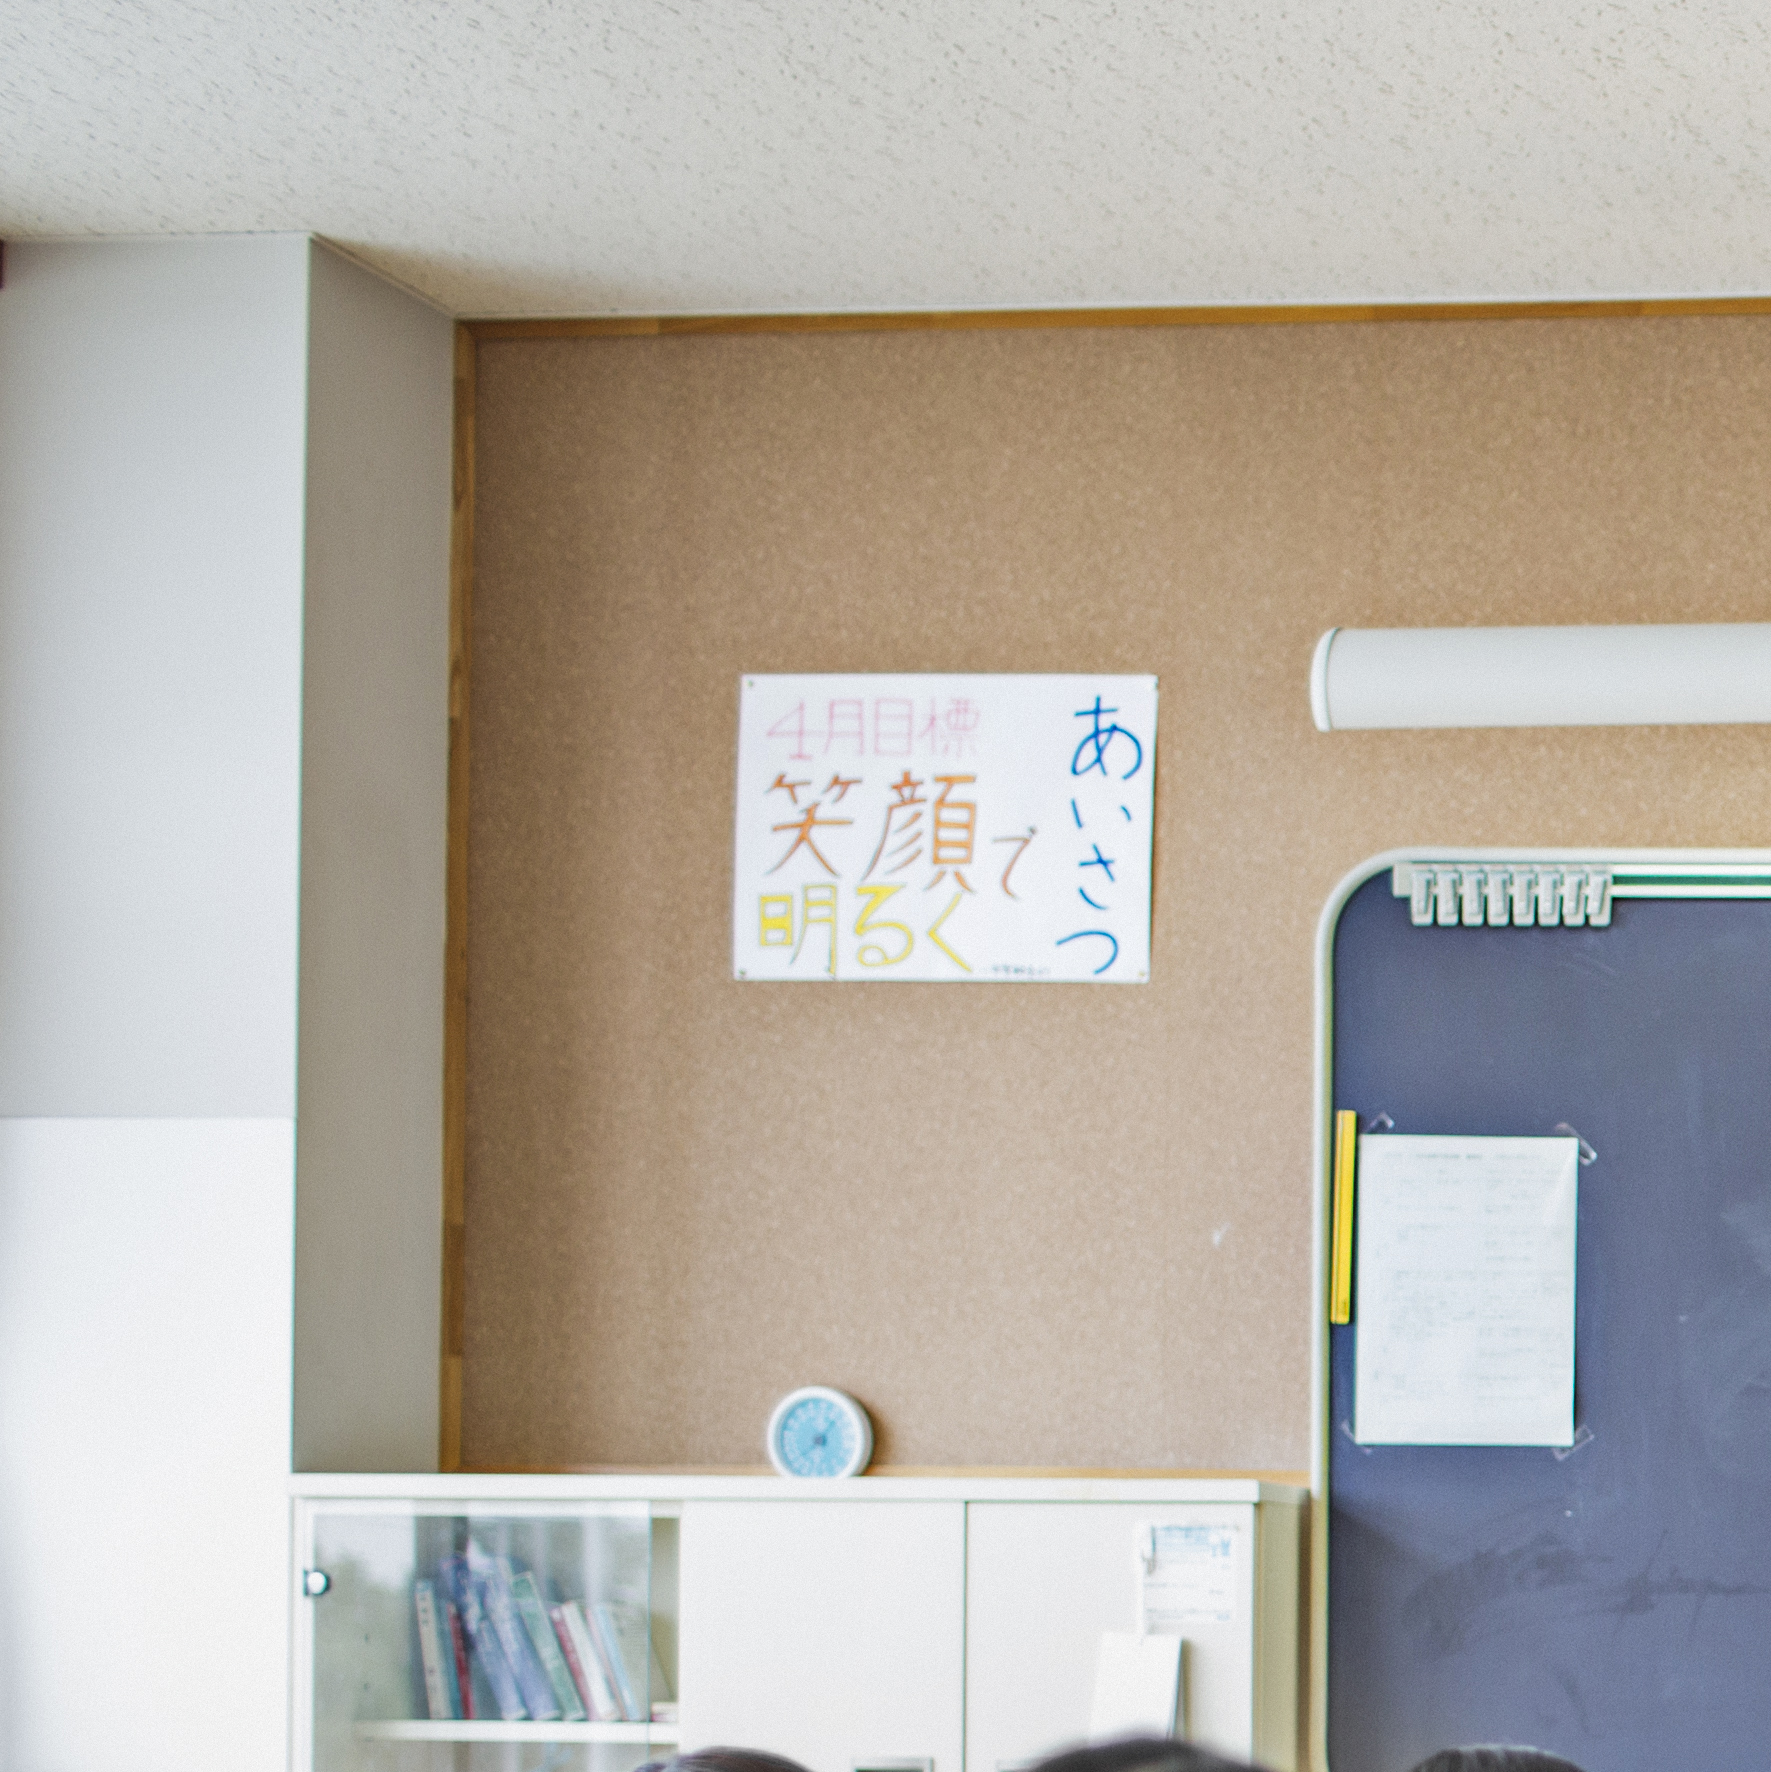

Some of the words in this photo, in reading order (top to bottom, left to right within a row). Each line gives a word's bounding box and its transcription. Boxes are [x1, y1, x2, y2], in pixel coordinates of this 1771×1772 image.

[765, 696, 981, 761] 4月目標
[765, 768, 1039, 901] 笑顔で
[1056, 694, 1144, 976] あいさつ
[758, 882, 973, 976] 明るく
